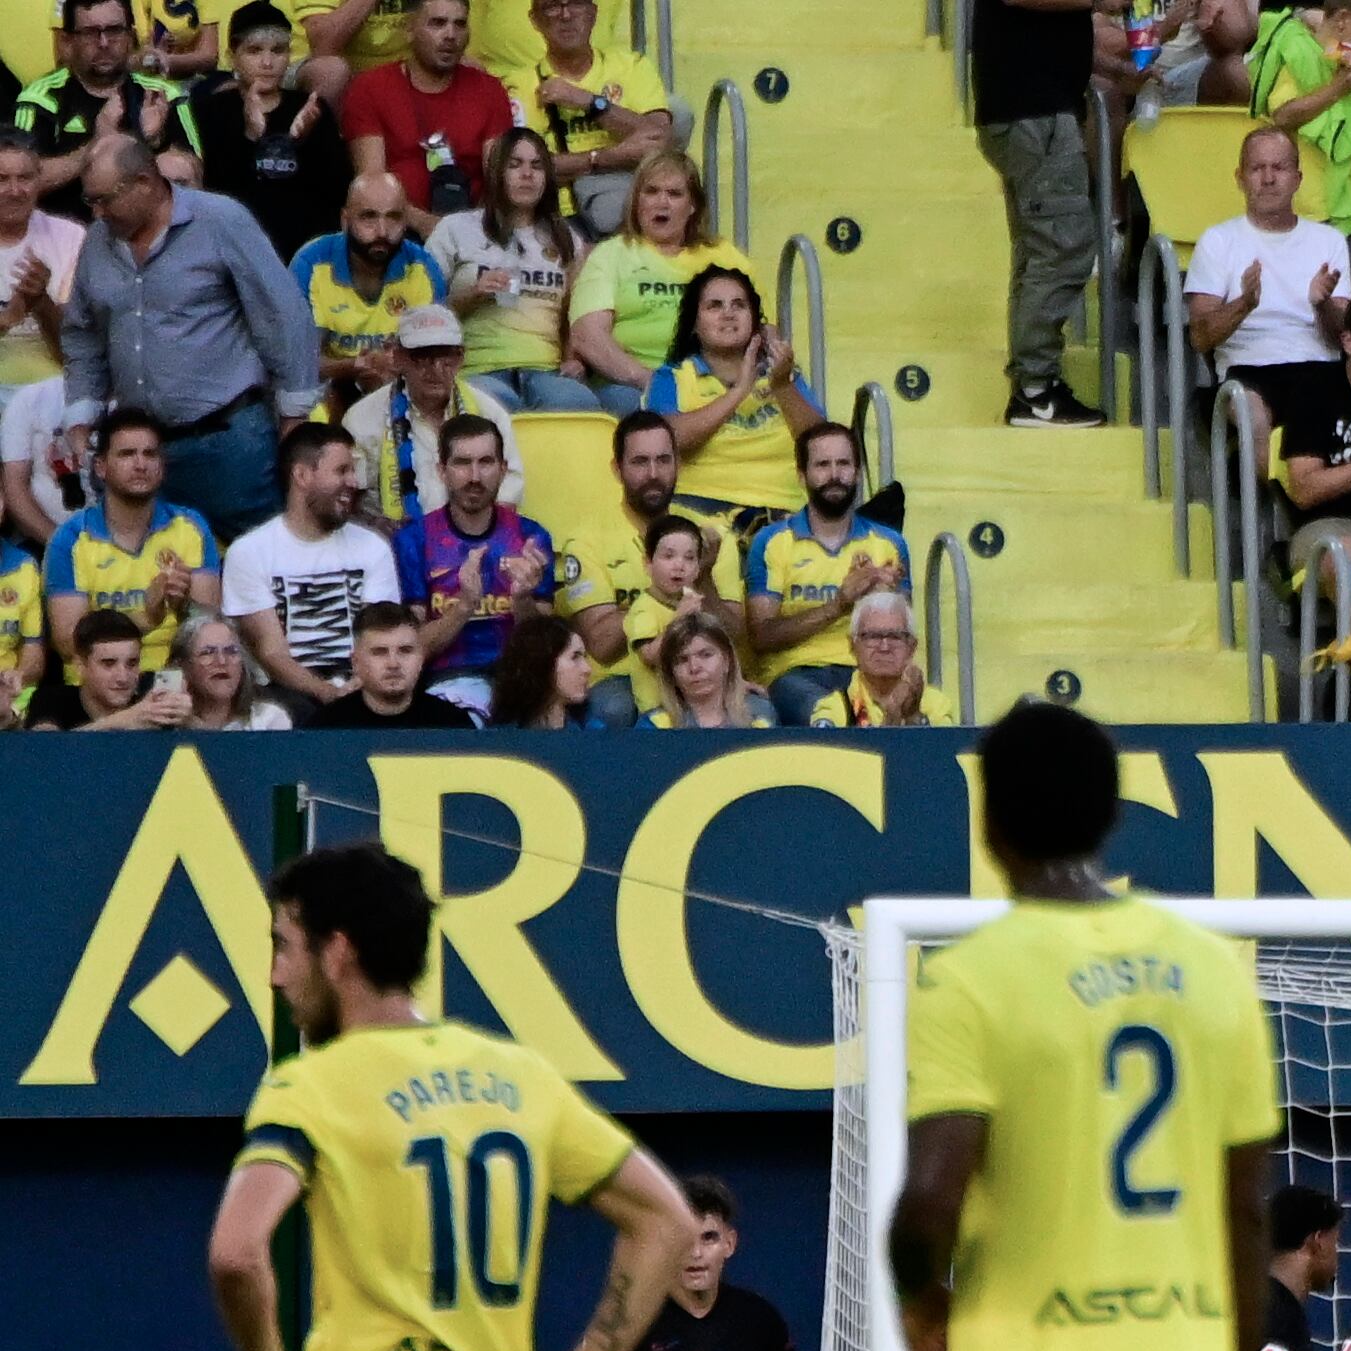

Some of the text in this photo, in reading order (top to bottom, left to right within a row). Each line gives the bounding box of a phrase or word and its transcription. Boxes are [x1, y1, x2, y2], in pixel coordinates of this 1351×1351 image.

[766, 72, 779, 91] 7
[836, 222, 850, 241] 6
[905, 369, 920, 388] 5
[978, 532, 994, 547] 4
[1056, 674, 1071, 694] 3
[1067, 954, 1185, 1007] COSTA
[385, 1069, 522, 1123] PAREJO
[1105, 1023, 1183, 1218] 2
[405, 1129, 533, 1313] 10
